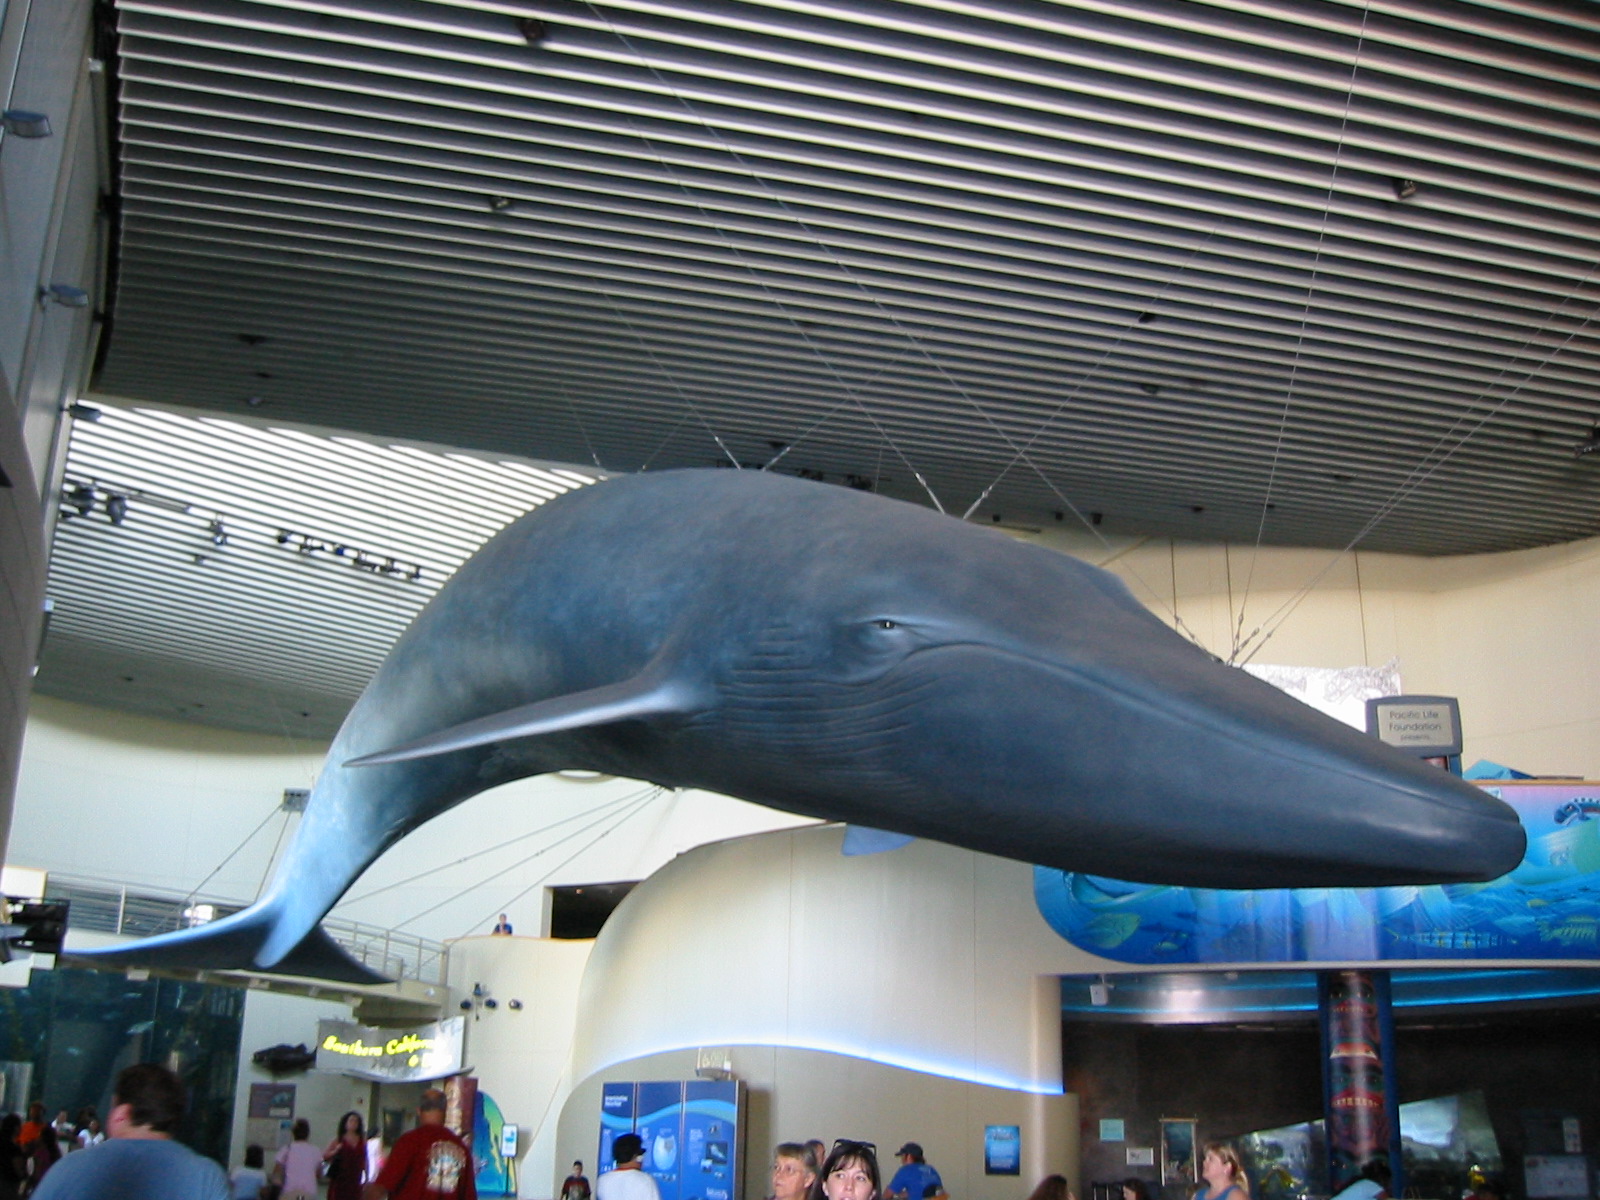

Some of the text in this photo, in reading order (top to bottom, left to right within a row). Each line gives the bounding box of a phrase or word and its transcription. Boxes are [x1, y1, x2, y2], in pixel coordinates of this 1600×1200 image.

[1389, 710, 1440, 719] Pacific Life
[1389, 721, 1442, 731] Foundation
[322, 1033, 446, 1057] Southern Californ
